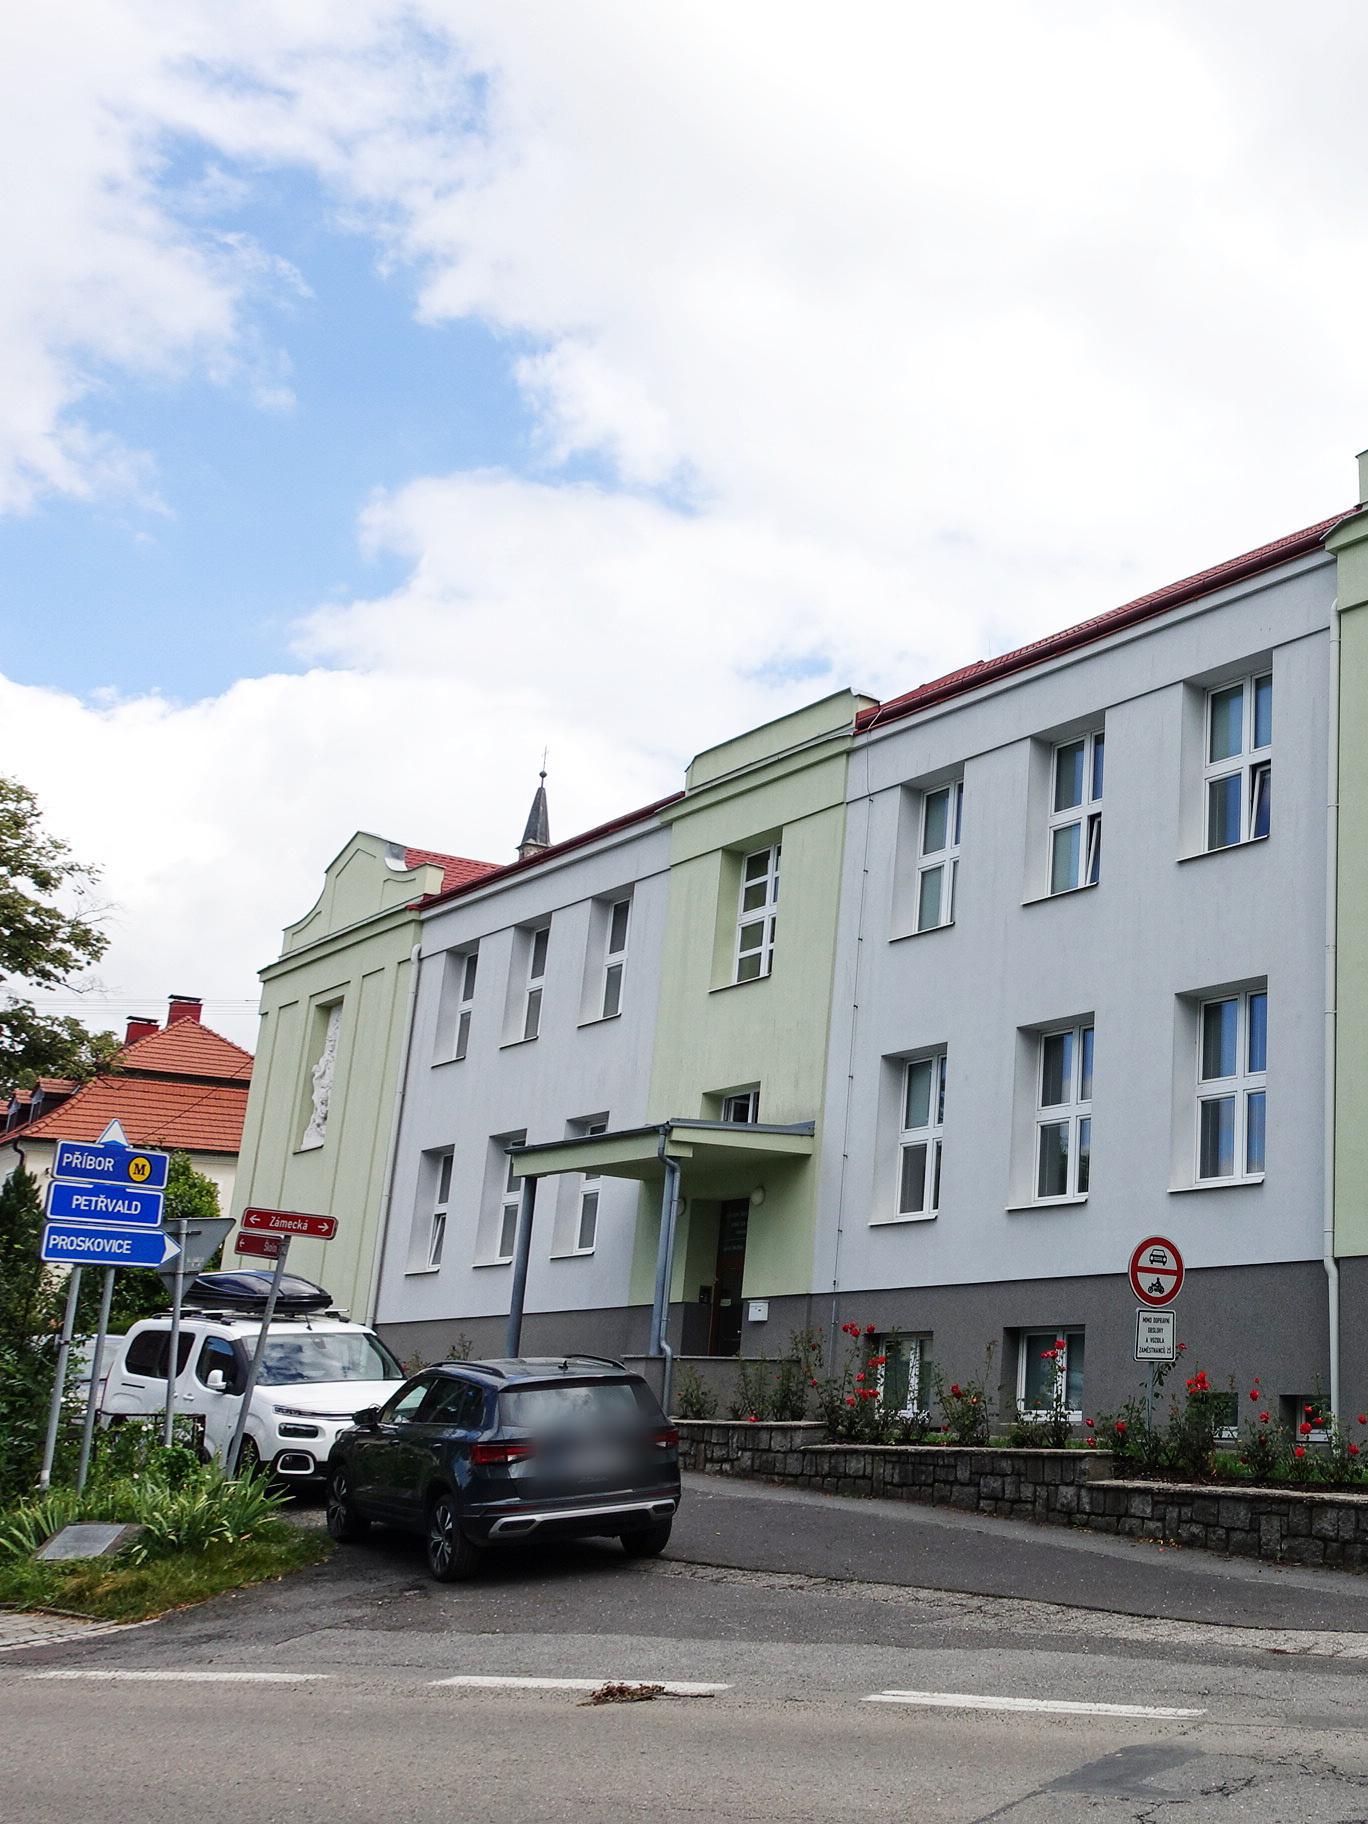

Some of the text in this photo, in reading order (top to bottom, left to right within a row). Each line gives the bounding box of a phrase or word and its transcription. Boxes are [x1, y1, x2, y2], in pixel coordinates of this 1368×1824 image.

[62, 1151, 146, 1176] PŘÍBOR M
[71, 1194, 141, 1215] PETŘVALD
[269, 1216, 308, 1231] Zámecká
[48, 1235, 132, 1254] PROSKOVICE
